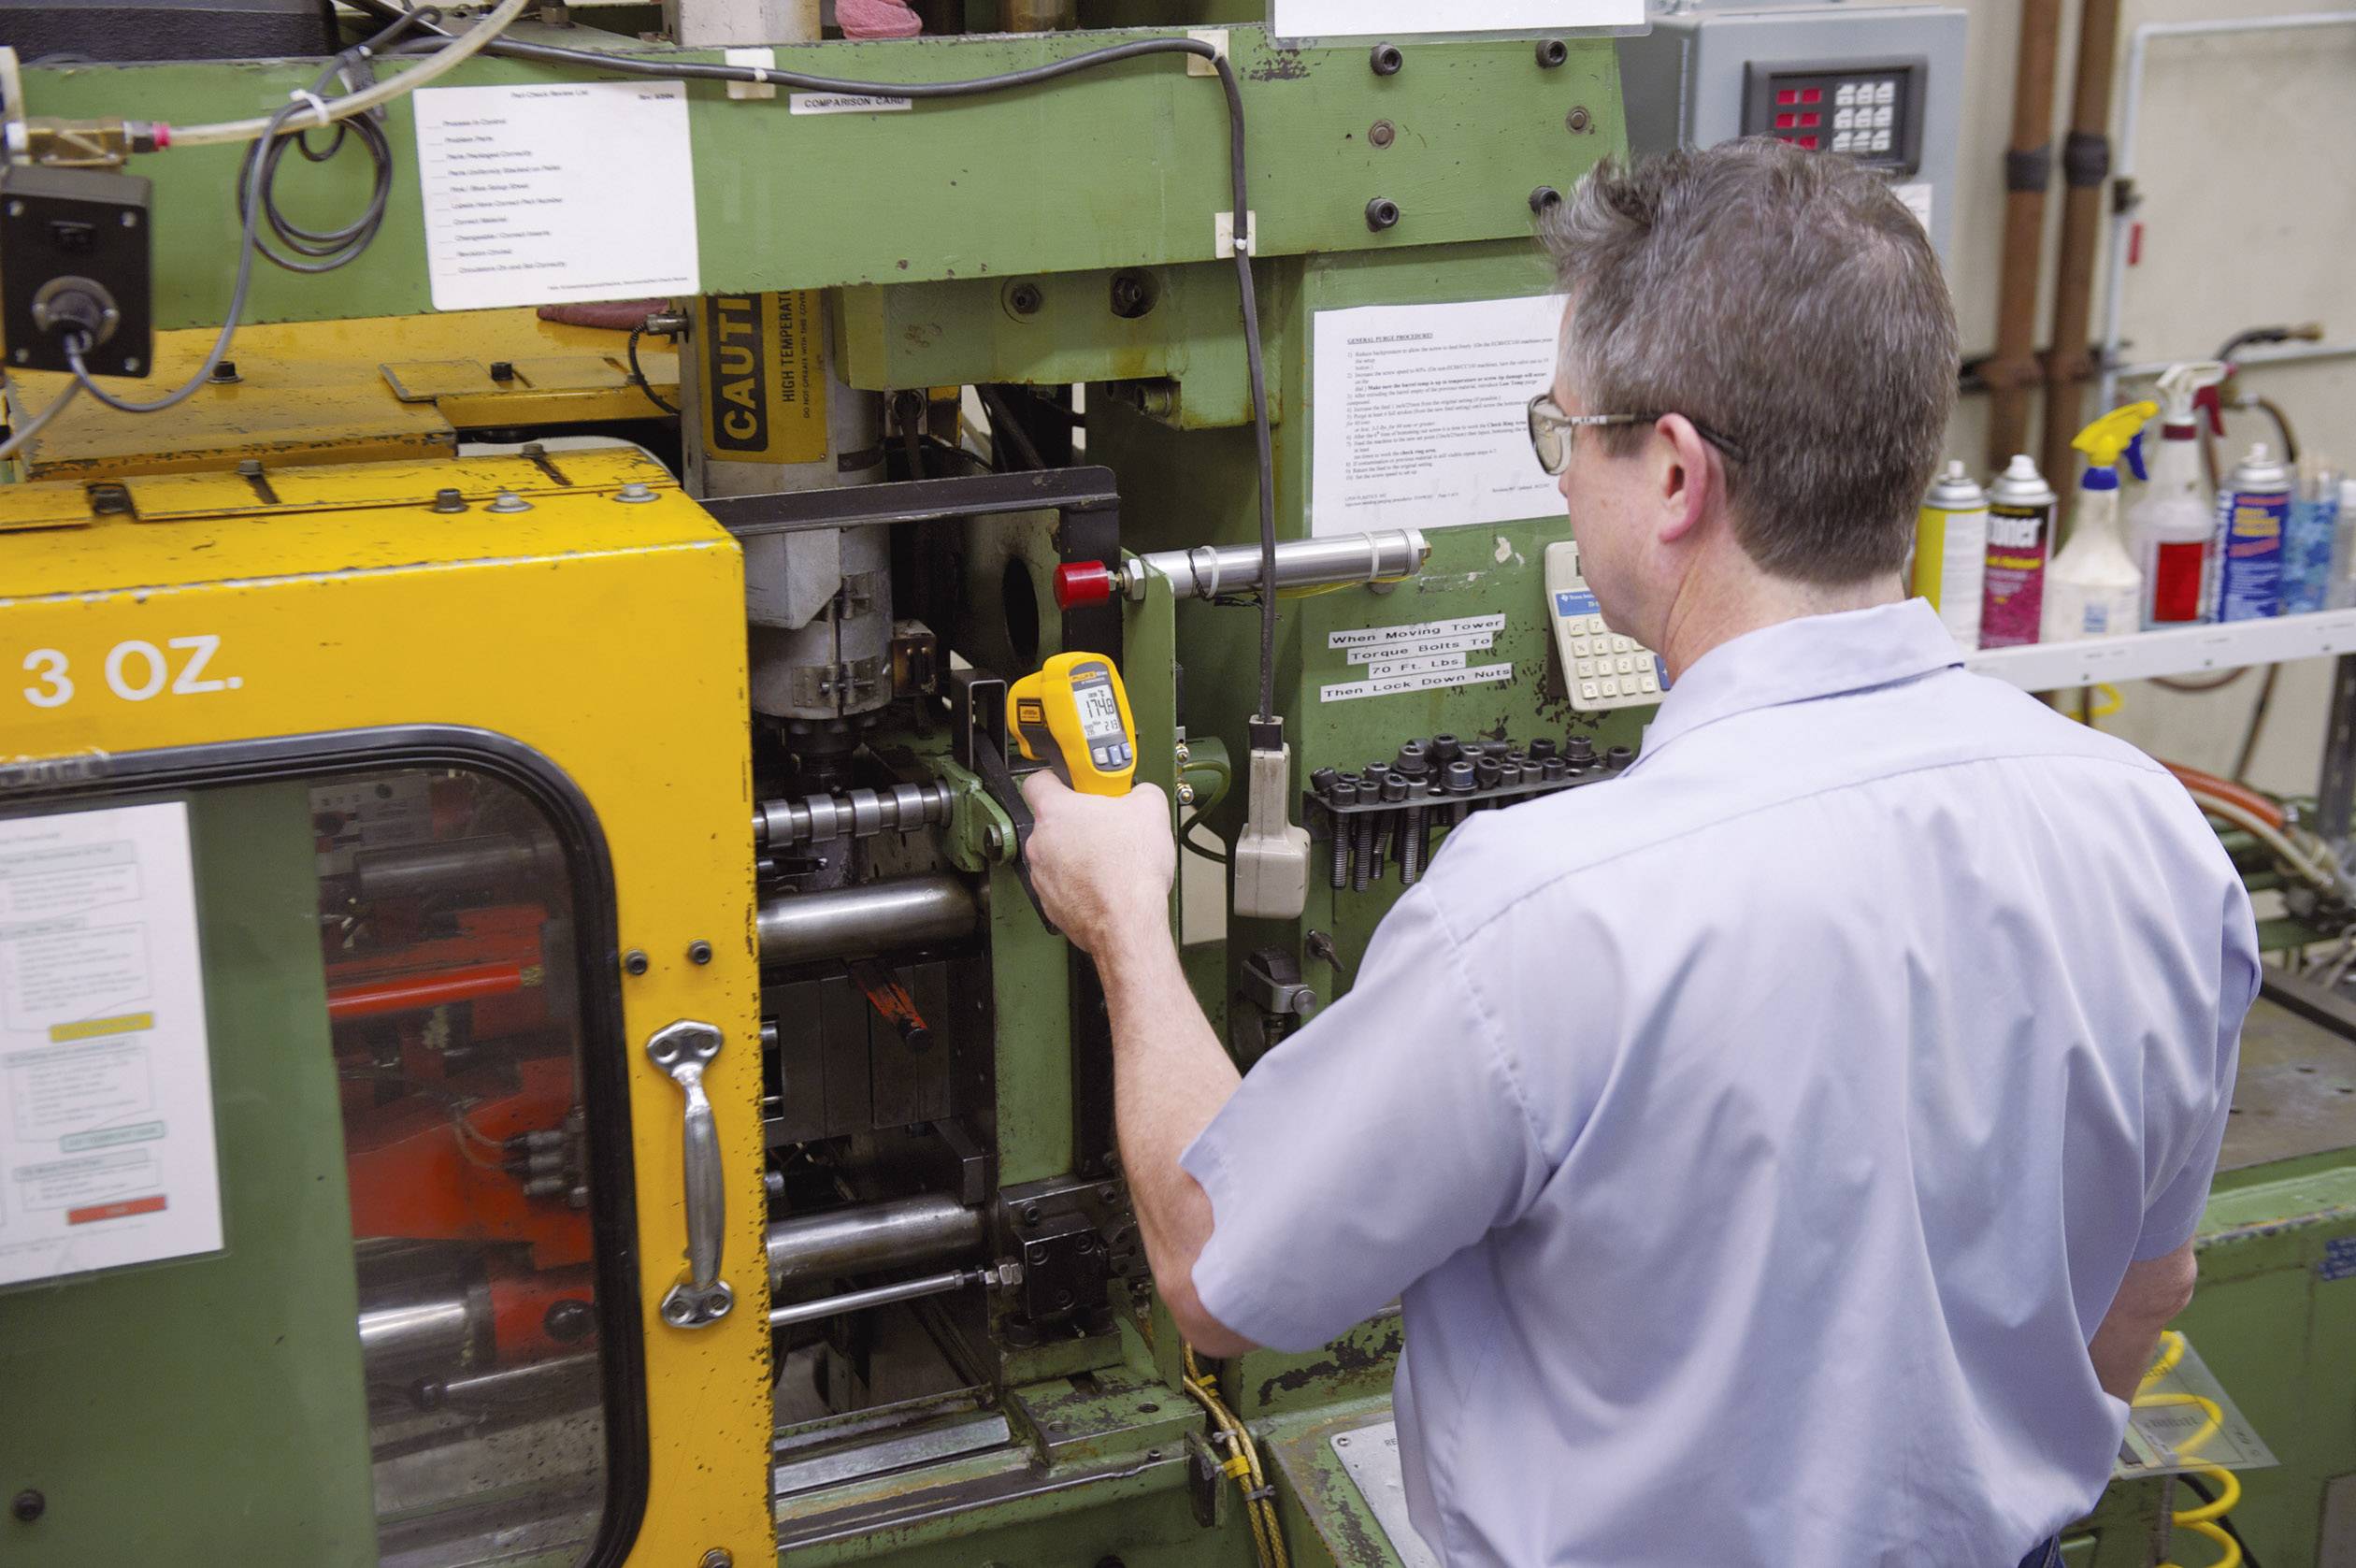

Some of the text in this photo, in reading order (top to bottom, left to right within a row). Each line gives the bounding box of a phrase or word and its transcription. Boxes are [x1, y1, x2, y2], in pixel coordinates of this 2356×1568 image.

[781, 370, 795, 402] HIGH
[1332, 621, 1502, 644] When Moving Tower
[1351, 638, 1490, 660] Torque Bolts To
[22, 635, 243, 708] 3 OZ.
[1372, 658, 1463, 674] 70 Ft. Lbs.
[1324, 668, 1510, 698] Then Lock Down Nuts
